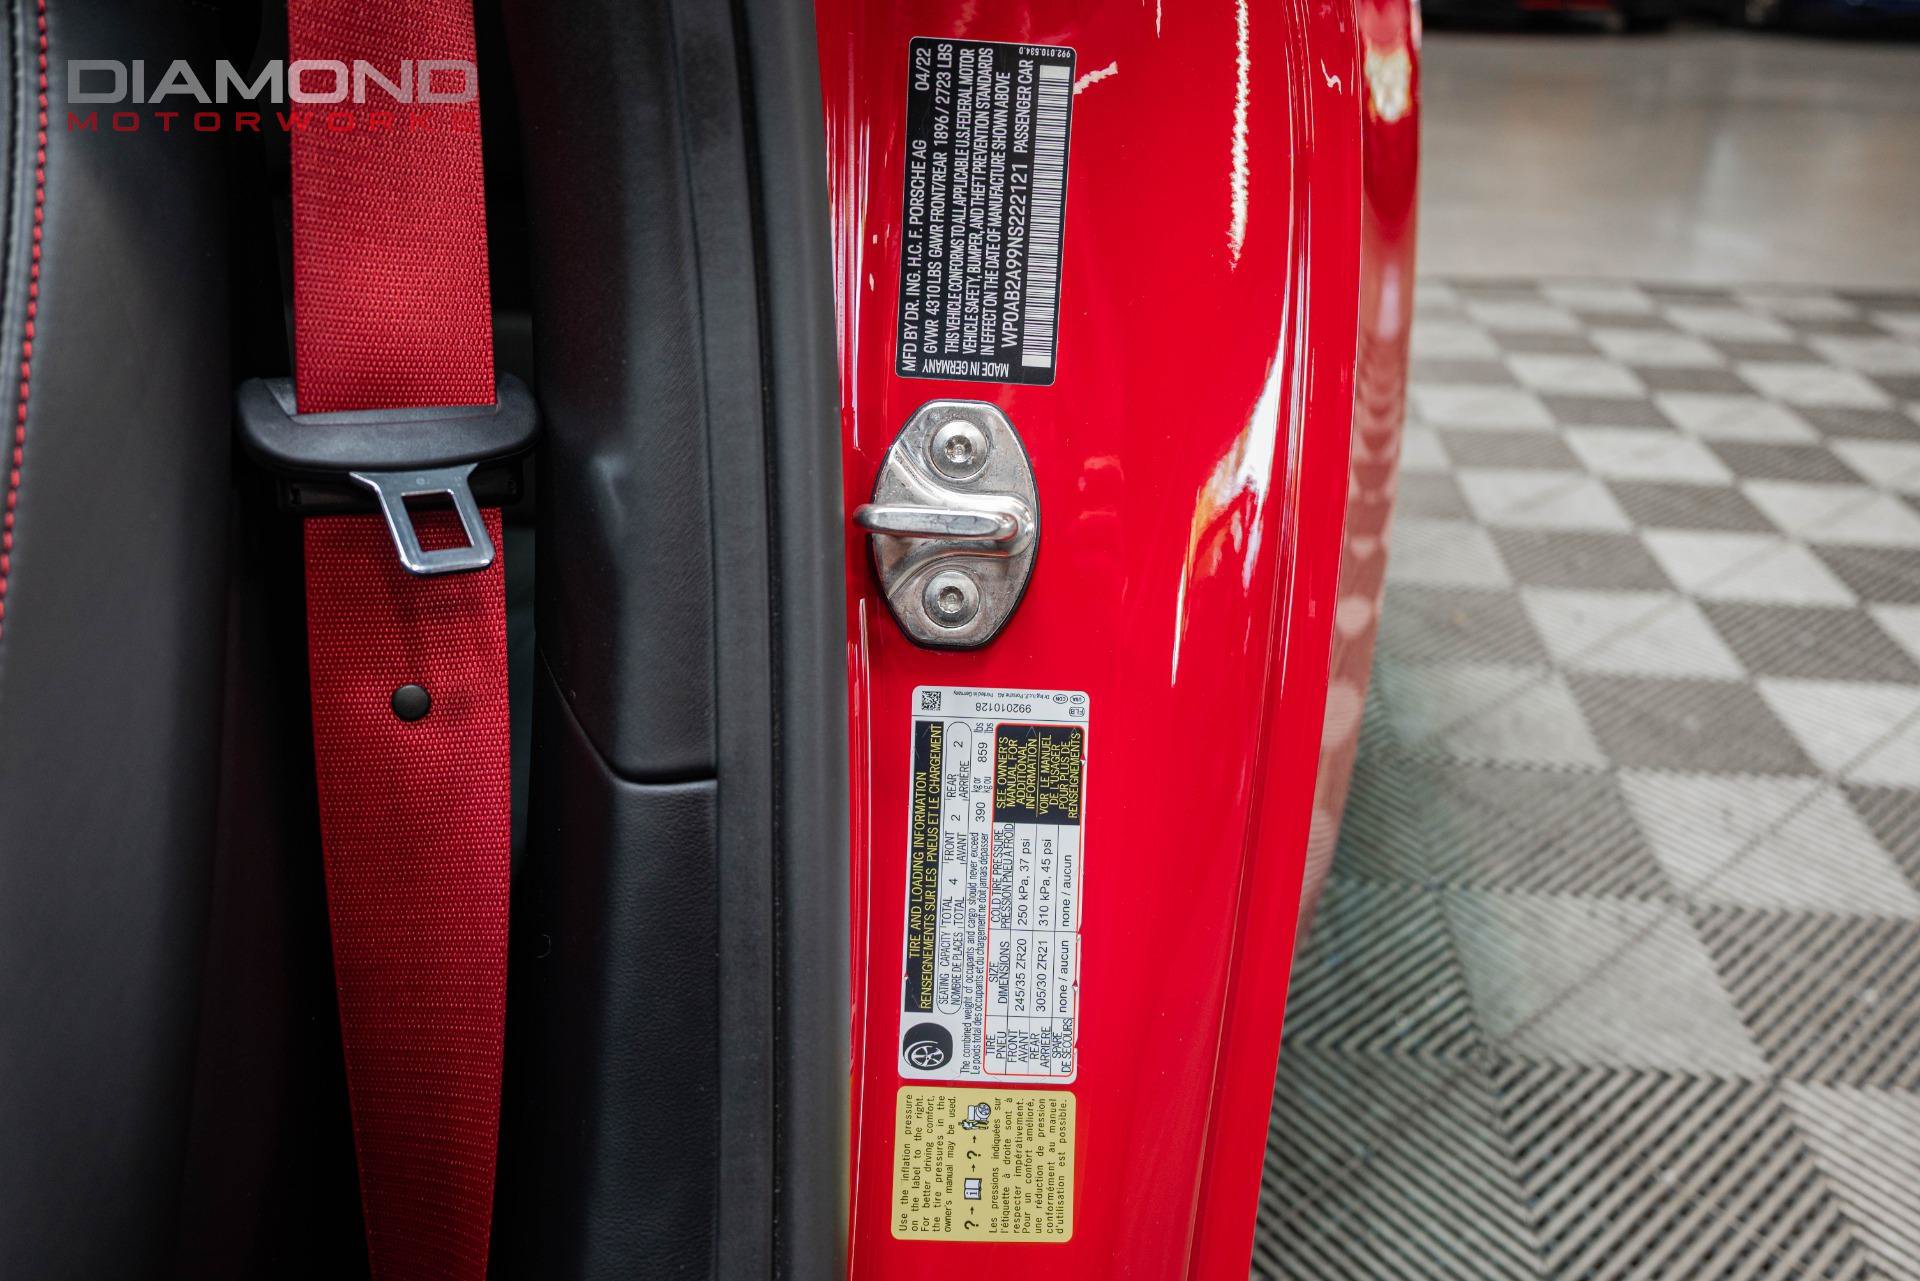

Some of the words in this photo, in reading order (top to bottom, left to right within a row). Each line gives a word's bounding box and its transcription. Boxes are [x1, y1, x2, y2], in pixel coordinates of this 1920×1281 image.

[937, 43, 952, 67] LBS
[958, 48, 974, 84] MOTOR
[915, 47, 931, 90] 04/22
[975, 47, 993, 109] STANDARDS
[1017, 59, 1033, 83] CAR
[935, 71, 951, 104] 2723
[994, 71, 1010, 107] ABOVE
[933, 115, 949, 146] 1896
[991, 109, 1008, 150] SHOWN
[1013, 86, 1032, 153] PASSENGER
[911, 139, 926, 158] AG
[972, 110, 989, 173] PREVENTION
[929, 151, 947, 221] FRONT/REAR
[952, 149, 969, 205] APPLICABLE
[987, 151, 1005, 226] MANUFACTURE
[908, 161, 925, 224] PORSCHE
[970, 174, 986, 206] THEFT
[951, 206, 966, 224] ALL
[969, 208, 984, 229] AND
[908, 227, 922, 237] F.
[928, 224, 943, 257] GAWR
[950, 225, 965, 237] TO
[986, 228, 1001, 241] OF
[906, 241, 922, 266] H.C.
[967, 230, 984, 273] BUMPER,
[985, 243, 1000, 268] DATE
[1001, 163, 1027, 348] WP0AB2A99NS222121
[926, 261, 941, 283] LBS
[948, 238, 964, 291] CONFORMS
[905, 269, 920, 295] ING.
[984, 270, 999, 290] THE
[925, 285, 940, 315] 4310
[964, 274, 982, 313] SAFETY,
[983, 291, 997, 306] ON
[904, 298, 919, 320] DR.
[946, 293, 961, 330] VEHICLE
[903, 322, 918, 339] BY
[923, 319, 939, 353] GVWR
[962, 314, 978, 354] VEHICLE
[981, 307, 996, 342] EFFECT
[945, 332, 959, 353] THIS
[980, 344, 994, 355] IN
[902, 343, 917, 371] MFD
[922, 358, 968, 374] GERMANY
[970, 361, 980, 375] IN
[981, 362, 1009, 377] MADE
[975, 702, 1031, 712] 992010128
[928, 723, 942, 793] CHARGEMENT
[977, 742, 987, 762] 859
[1008, 739, 1017, 759] FOR
[1040, 734, 1051, 773] MANUEL
[1060, 741, 1070, 753] DE
[997, 736, 1008, 784] OWNER'S
[1049, 744, 1060, 789] L'USAGER
[1059, 756, 1069, 780] PLUS
[946, 773, 956, 797] REAR
[1006, 761, 1017, 806] MANUAL
[1016, 742, 1027, 804] ADDITIONAL
[1025, 738, 1037, 808] INFORMATION
[1040, 776, 1049, 787] LE
[1068, 732, 1080, 817] RENSEIGNEMENTS
[928, 796, 939, 808] LE
[996, 788, 1006, 808] SEE
[1039, 793, 1049, 814] VOIR
[1049, 792, 1058, 804] DE
[1058, 783, 1068, 809] POUR
[913, 772, 927, 847] INFORMATION
[927, 812, 939, 824] ET
[975, 802, 985, 822] 390
[925, 827, 938, 861] PNEUS
[943, 830, 954, 860] FRONT
[956, 832, 966, 861] AVANT
[992, 829, 1003, 874] PRESSURE
[1020, 838, 1032, 854] psi
[1041, 838, 1053, 854] psi
[911, 851, 924, 901] LOADING
[925, 867, 936, 887] LES
[1019, 858, 1029, 871] 37
[1040, 858, 1050, 872] 45
[991, 877, 1002, 895] TIRE
[924, 890, 936, 910] SUR
[941, 896, 952, 924] TOTAL
[990, 898, 1001, 922] COLD
[910, 906, 922, 929] AND
[1017, 904, 1027, 925] 250
[1038, 905, 1049, 926] 310
[909, 934, 920, 958] TIRE
[939, 931, 950, 966] CAPACITY
[1016, 938, 1026, 969] ZR20
[1037, 940, 1047, 970] ZR21
[920, 914, 935, 1008] RENSEIGNEMENTS
[988, 961, 999, 982] SIZE
[998, 941, 1009, 1003] DIMENSIONS
[938, 973, 949, 1004] SEATING
[1014, 972, 1025, 1011] 245/35
[1035, 973, 1046, 1012] 305/30
[985, 1034, 995, 1055] TIRE
[996, 1031, 1006, 1058] PNEU
[1007, 1029, 1017, 1062] FRONT
[1018, 1029, 1028, 1062] AVANT
[1029, 1033, 1039, 1059] REAR
[904, 1094, 914, 1134] pressure
[914, 1095, 924, 1118] right.
[936, 1095, 944, 1109] the
[936, 1118, 944, 1126] in
[946, 1124, 954, 1134] be
[1004, 1110, 1012, 1129] sont
[913, 1127, 922, 1141] the
[991, 1118, 1002, 1158] indiquées
[913, 1149, 921, 1158] to
[923, 1141, 934, 1171] driving
[935, 1135, 945, 1182] pressures
[947, 1140, 955, 1157] may
[1002, 1138, 1011, 1164] droite
[901, 1143, 910, 1180] inflation
[1023, 1149, 1032, 1183] confort
[911, 1166, 920, 1188] label
[944, 1164, 953, 1193] manual
[990, 1167, 1000, 1208] pressions
[900, 1189, 908, 1204] the
[911, 1197, 919, 1211] the
[922, 1180, 931, 1207] better
[932, 1191, 941, 1207] tire
[1024, 1192, 1031, 1202] un
[943, 1200, 951, 1232] owner's
[1012, 1185, 1022, 1233] respecter
[899, 1213, 907, 1231] Use
[911, 1220, 918, 1231] on
[921, 1216, 929, 1231] For
[932, 1216, 940, 1231] the
[989, 1217, 997, 1232] Les
[1022, 1211, 1030, 1233] Pour
